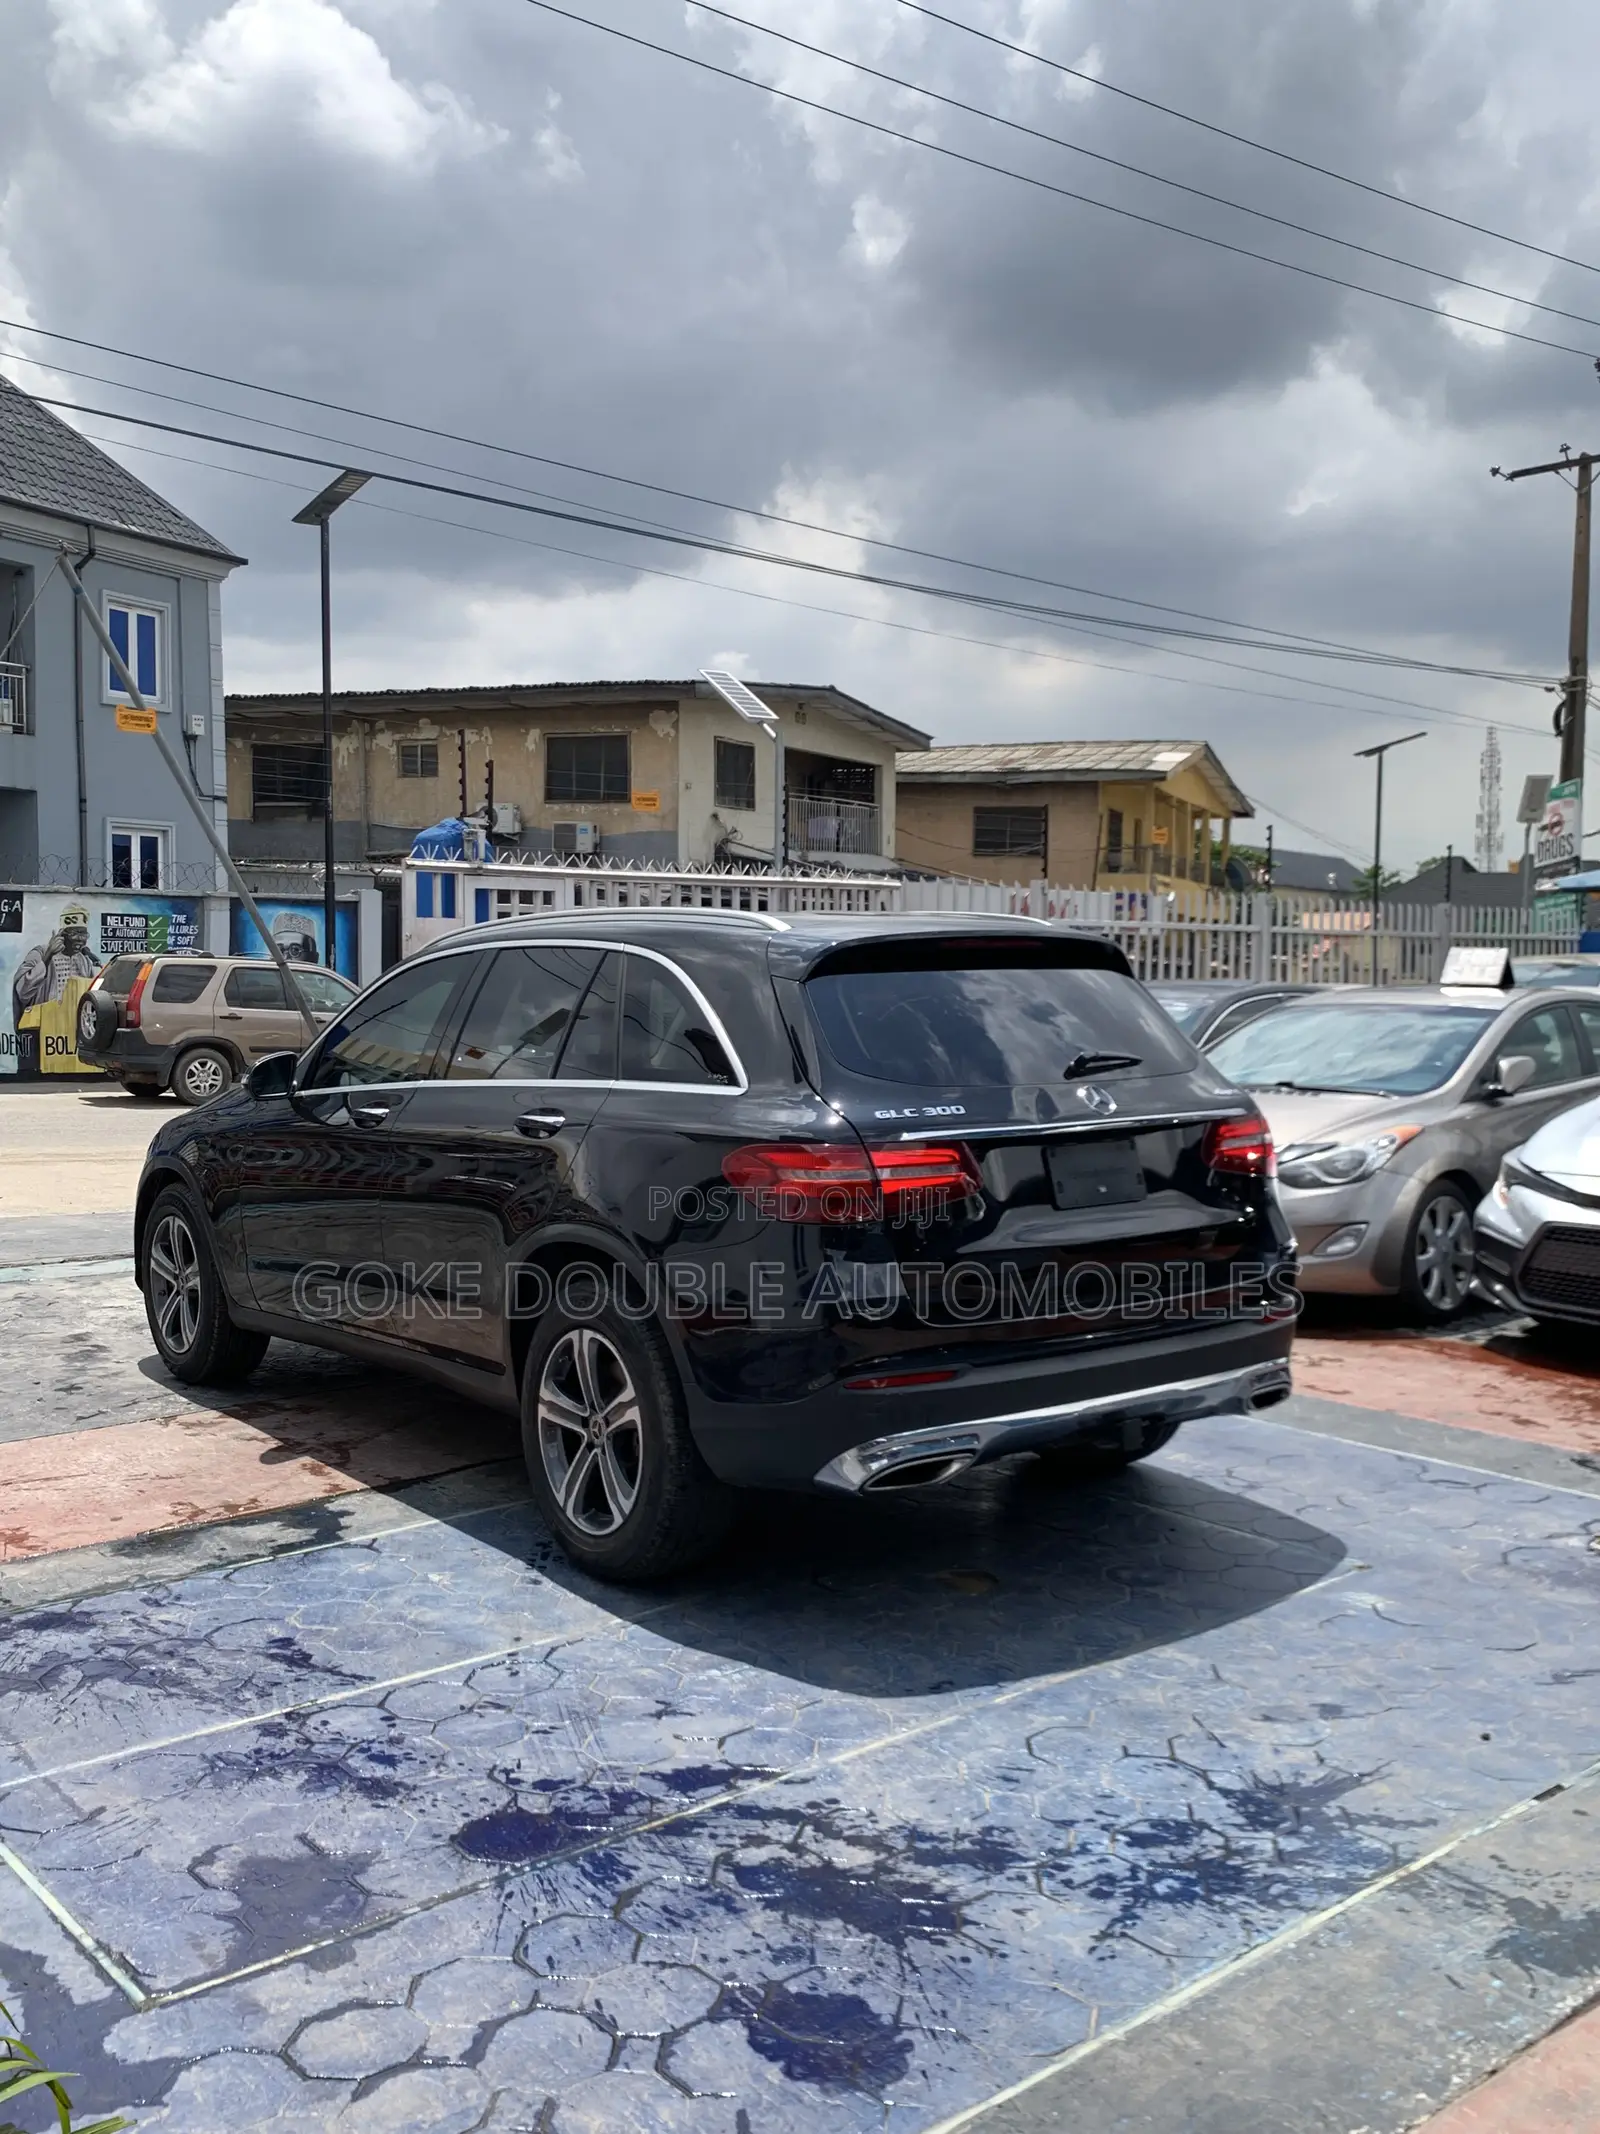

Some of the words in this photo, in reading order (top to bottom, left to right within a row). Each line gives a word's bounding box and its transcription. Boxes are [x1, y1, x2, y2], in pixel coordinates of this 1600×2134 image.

[1538, 832, 1574, 862] DRUGS
[107, 916, 146, 927] NELFUND
[171, 914, 187, 924] THE
[115, 929, 146, 938] AUTONOMY
[167, 925, 199, 934] ALLURES
[167, 936, 176, 945] OF
[177, 936, 195, 945] SOFT
[101, 941, 122, 952] STATE
[124, 941, 148, 952] POLICE
[0, 1033, 33, 1057] DENT
[45, 1034, 78, 1056] BOL
[874, 1108, 919, 1119] GLC
[921, 1105, 966, 1116] 300
